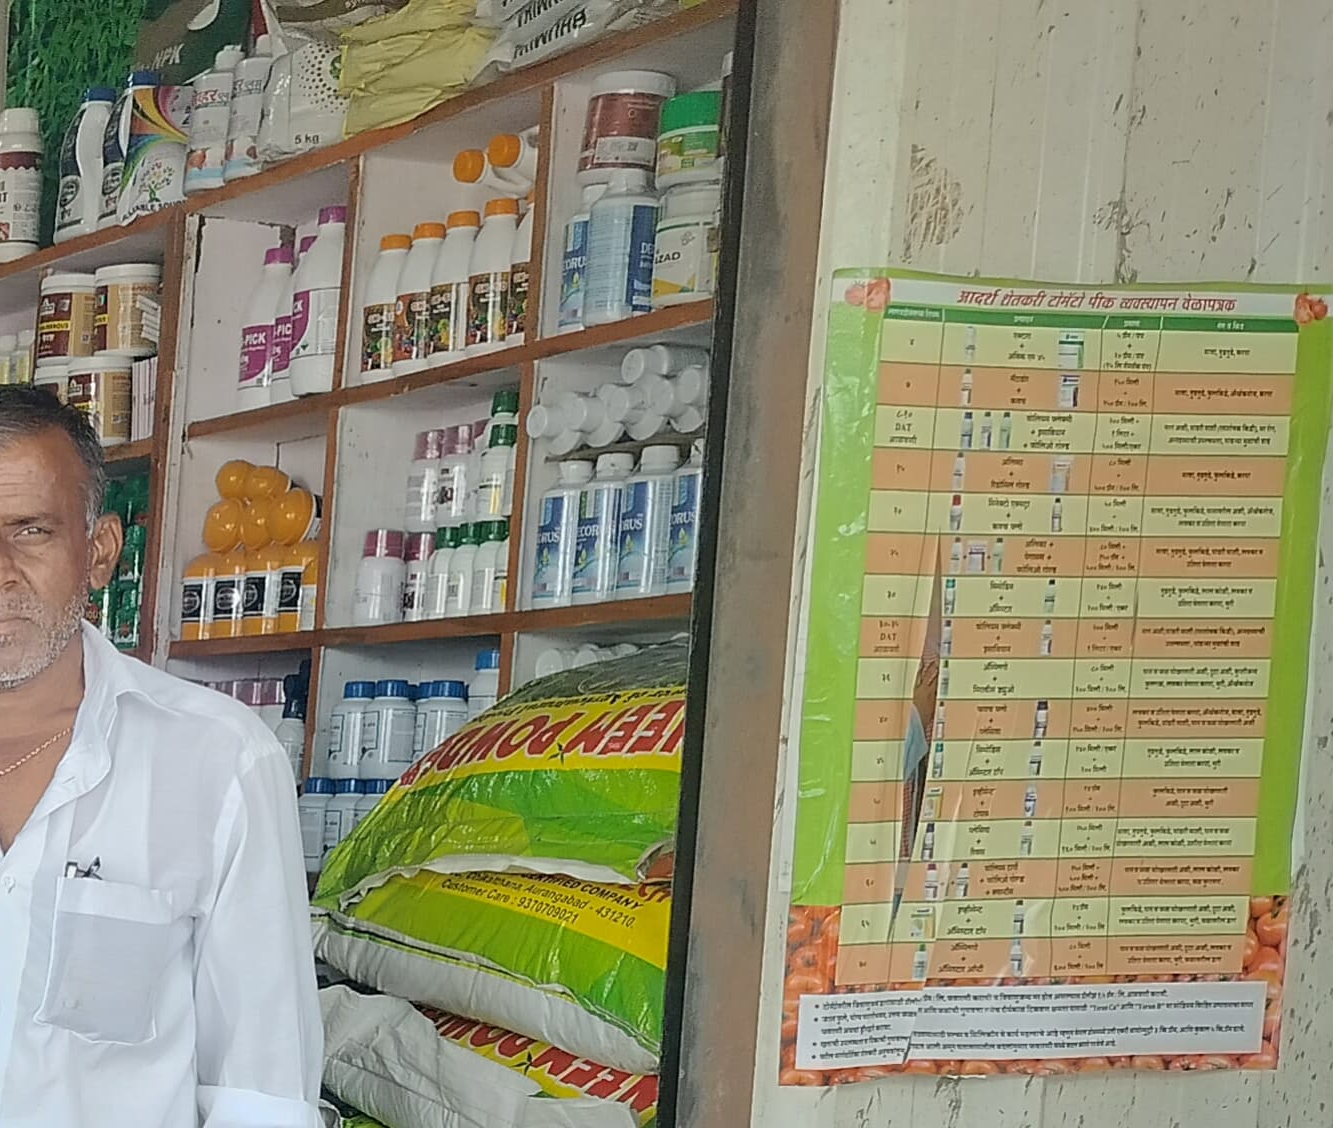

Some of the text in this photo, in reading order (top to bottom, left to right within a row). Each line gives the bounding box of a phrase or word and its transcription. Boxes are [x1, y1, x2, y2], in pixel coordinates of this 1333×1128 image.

[957, 289, 999, 306] आदर्श
[1000, 289, 1045, 307] शेतकरी
[1119, 296, 1179, 312] व्यवस्थापन
[1181, 292, 1238, 313] वेळापत्रक
[441, 879, 485, 897] Customer
[485, 888, 511, 904] Care
[516, 896, 580, 925] 9370709021
[525, 884, 589, 910] Aurangabad
[581, 881, 645, 911] COMPANY
